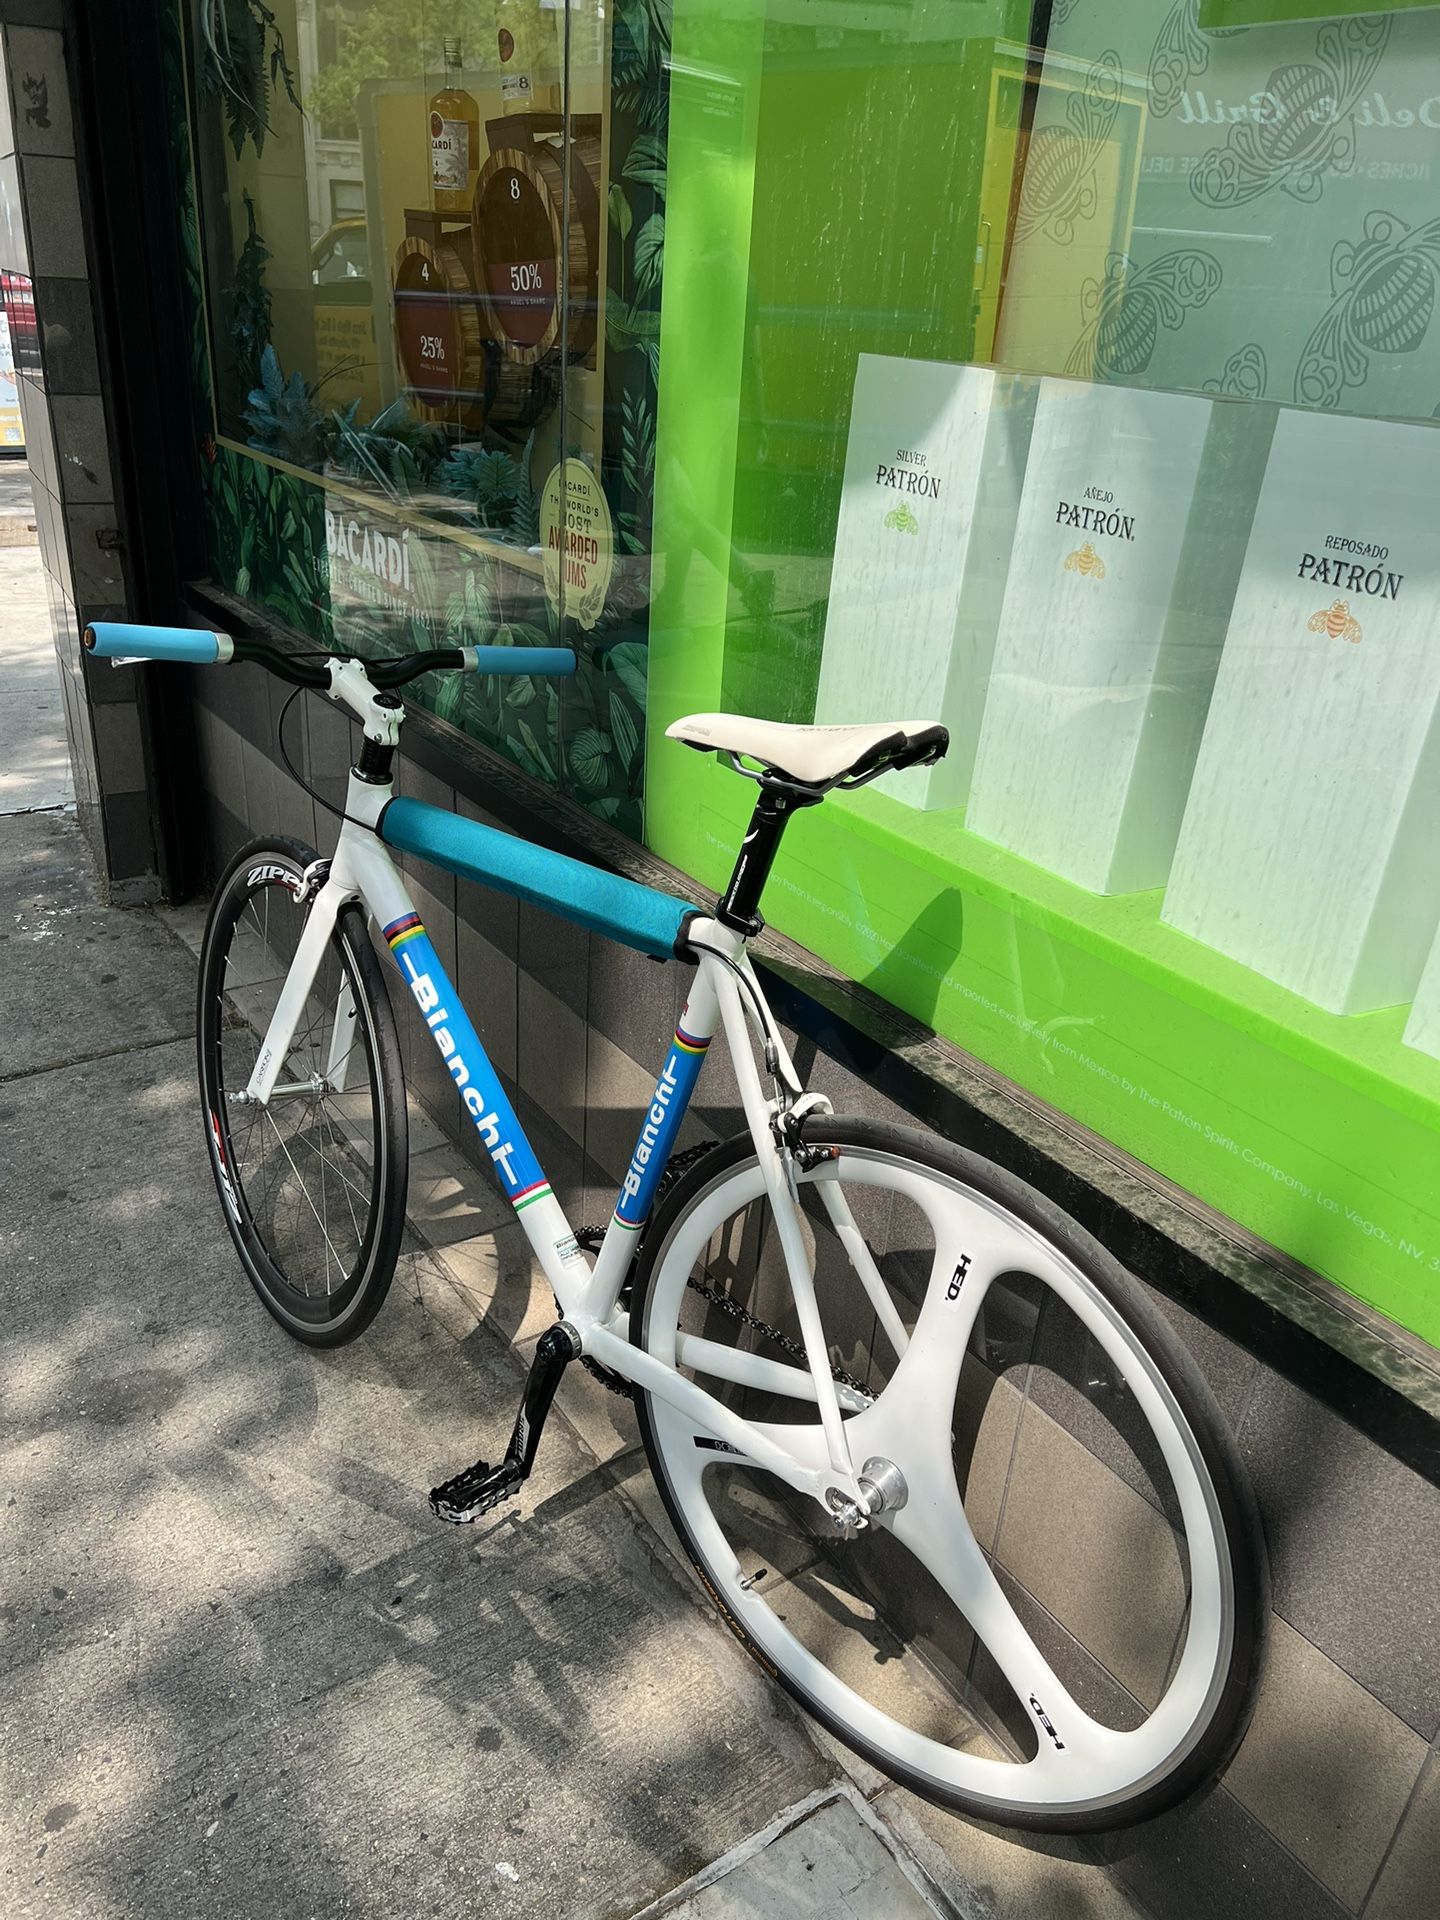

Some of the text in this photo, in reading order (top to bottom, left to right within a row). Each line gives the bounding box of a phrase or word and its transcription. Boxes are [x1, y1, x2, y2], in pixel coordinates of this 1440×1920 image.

[519, 76, 529, 89] 8
[431, 138, 452, 151] CARDÍ
[510, 177, 520, 200] 8
[421, 262, 430, 282] 4
[510, 263, 542, 292] 50%
[420, 335, 445, 360] 25%
[896, 449, 927, 468] SILVER
[876, 464, 941, 499] PATRÓN
[1083, 486, 1114, 504] AÑEJO
[325, 508, 410, 592] BACARDÍ
[1324, 534, 1389, 561] REPOSADO
[564, 558, 587, 590] UMS
[1297, 553, 1404, 601] PATRÓN
[402, 952, 517, 1186] Bianchi
[953, 982, 998, 1015] imported
[1052, 1036, 1077, 1060] from
[1078, 1053, 1120, 1084] Mexico
[1121, 1078, 1137, 1096] by
[1139, 1086, 1161, 1108] The
[1203, 1125, 1239, 1155] Spirits
[1316, 1191, 1341, 1214] Las
[620, 1055, 679, 1209] Bianchi
